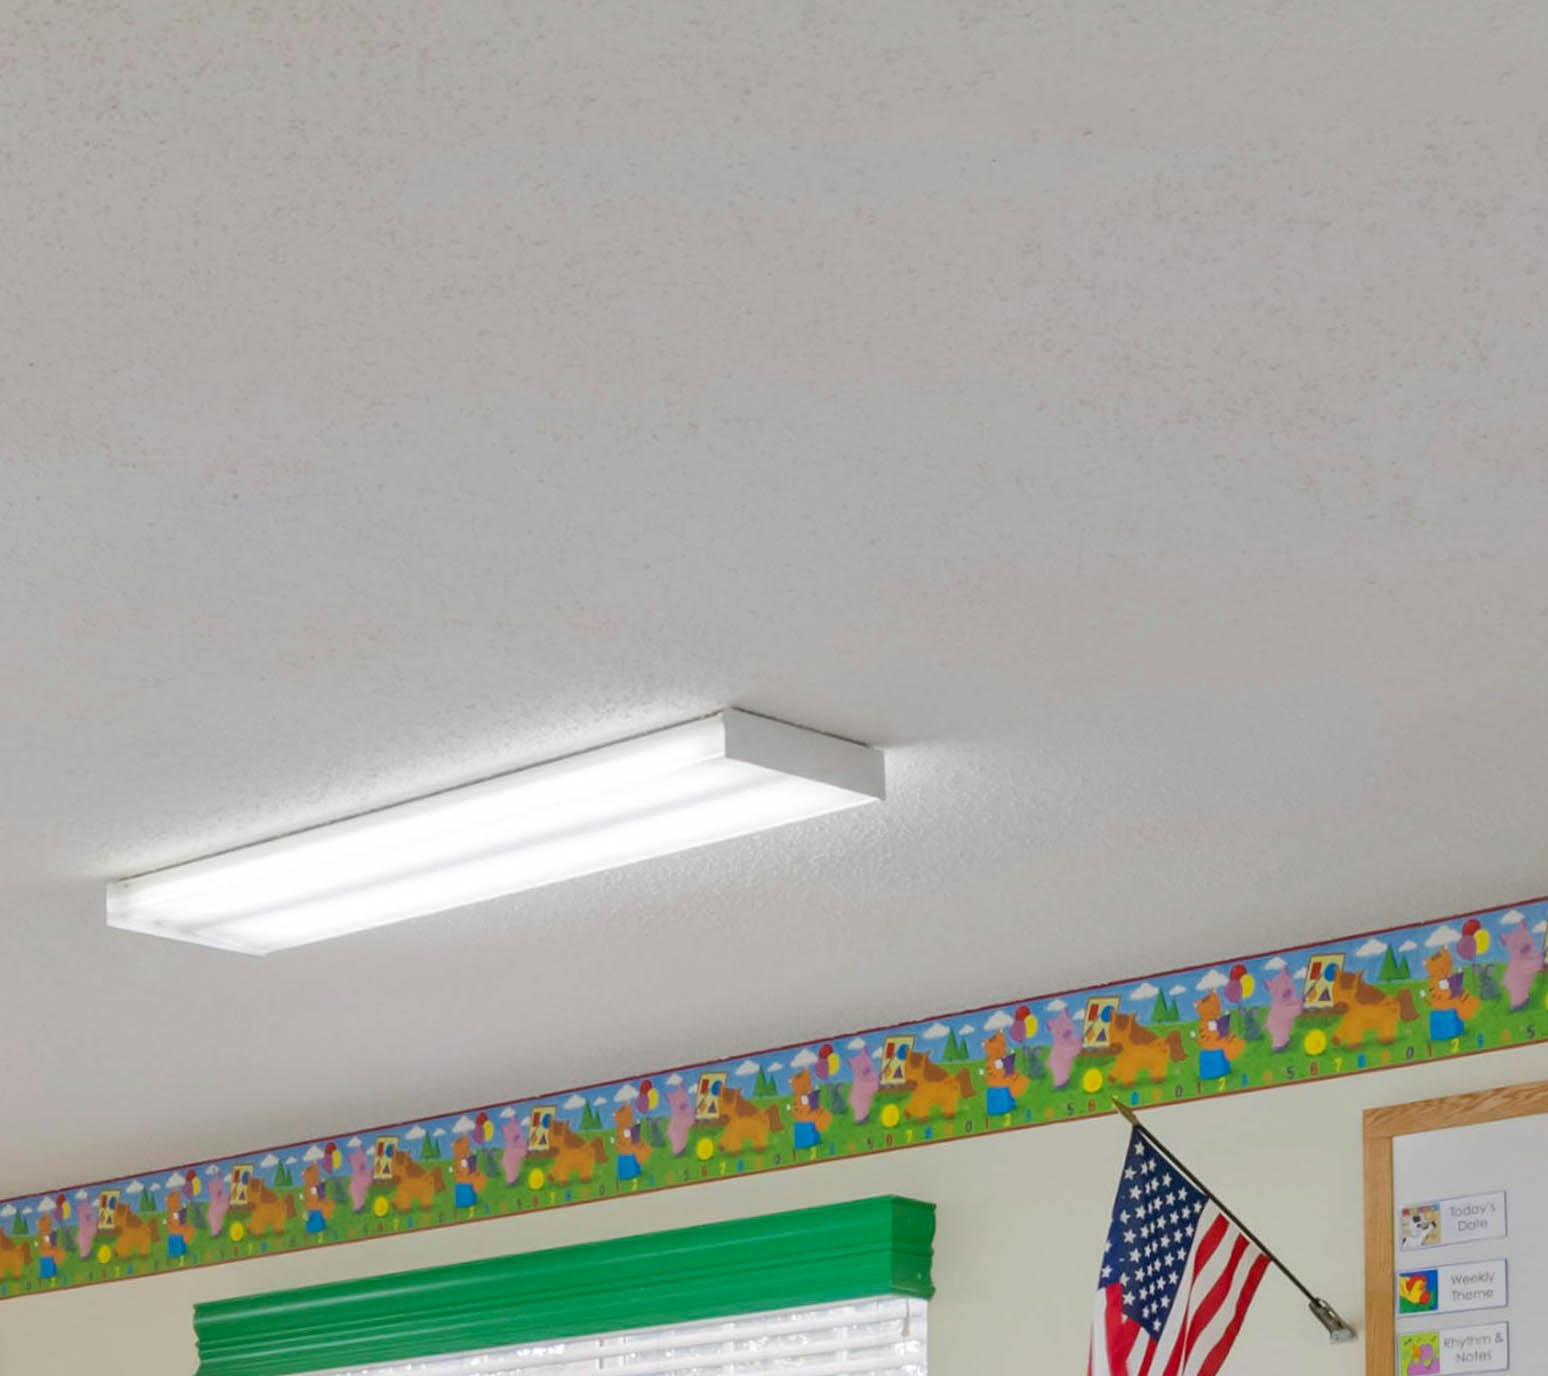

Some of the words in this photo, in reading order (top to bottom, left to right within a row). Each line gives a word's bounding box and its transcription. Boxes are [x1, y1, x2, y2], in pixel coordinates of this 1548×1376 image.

[1450, 1203, 1496, 1218] Today's
[1457, 1220, 1488, 1232] Date
[1450, 1271, 1496, 1285] Weekly
[1451, 1288, 1494, 1301] Theme
[1443, 1334, 1492, 1349] Rhythm
[1495, 1332, 1504, 1343] &
[1456, 1349, 1492, 1363] Notes
